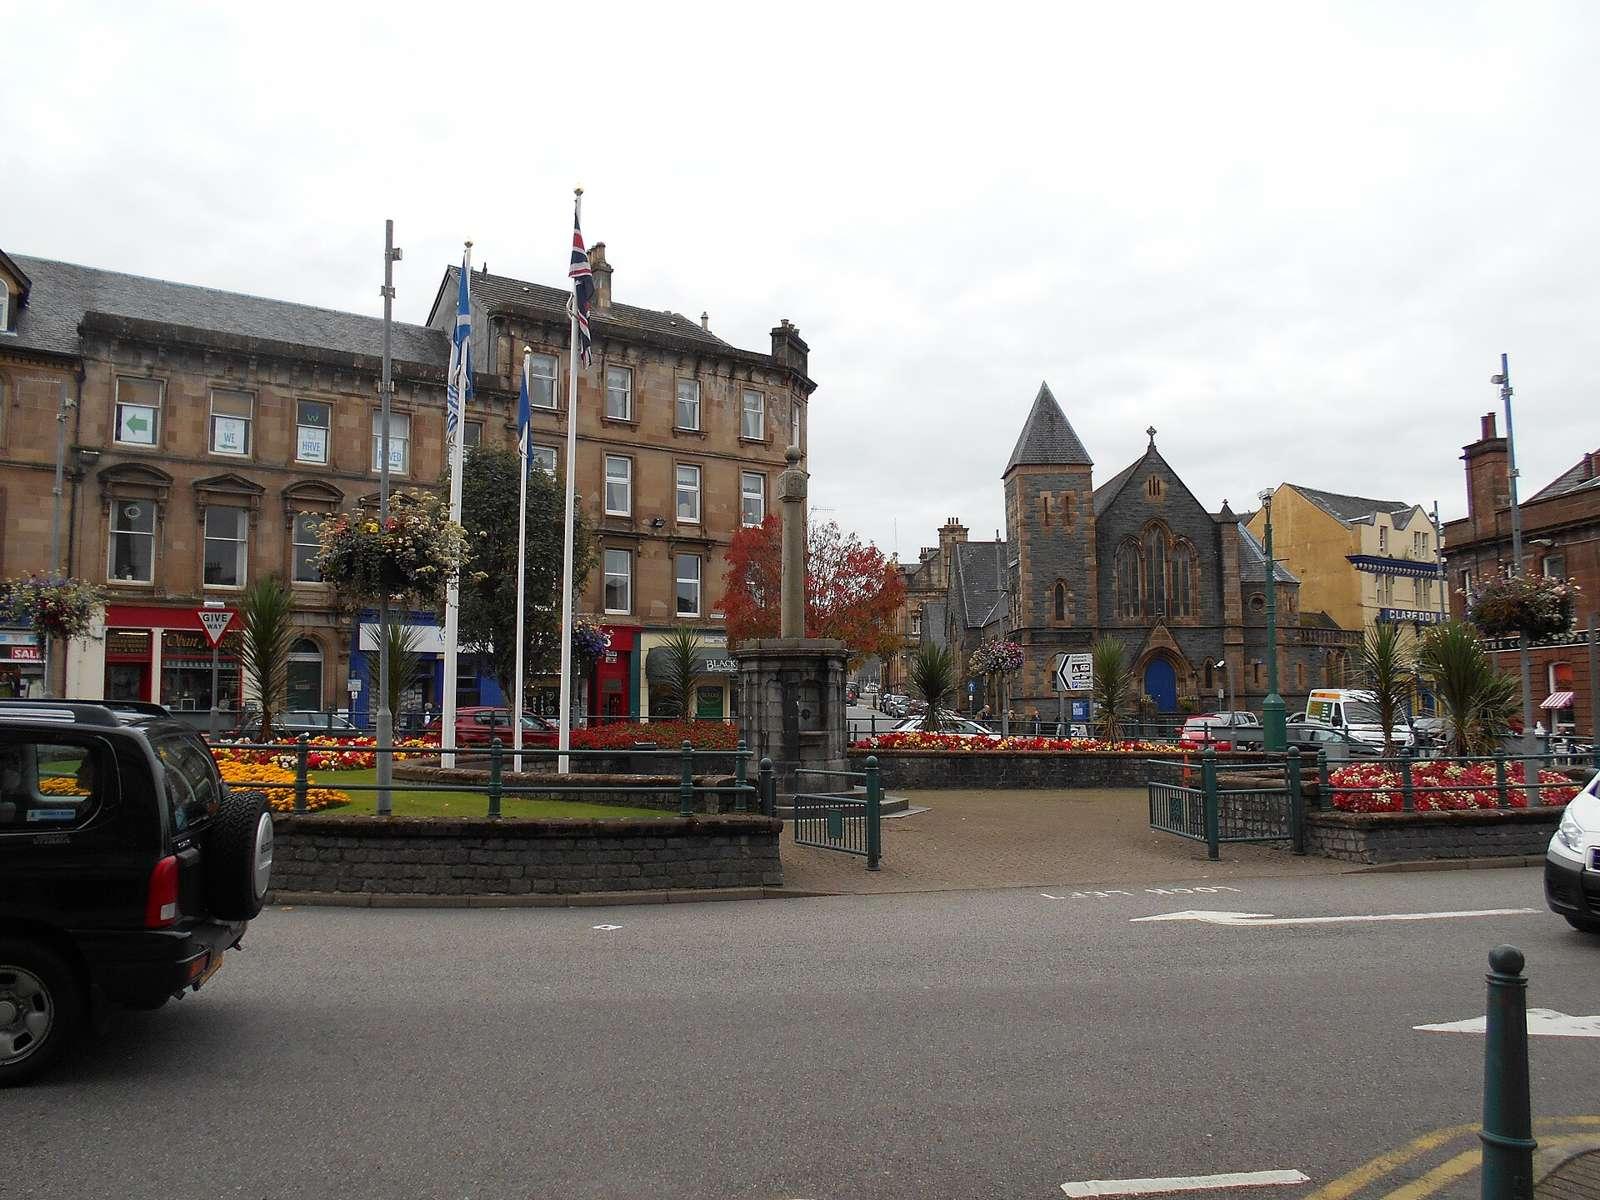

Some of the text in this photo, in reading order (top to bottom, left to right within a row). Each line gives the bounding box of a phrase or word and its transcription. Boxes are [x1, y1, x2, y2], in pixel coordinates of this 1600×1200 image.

[223, 432, 235, 443] WE
[302, 440, 320, 451] HAVE
[202, 614, 227, 622] GIVE
[14, 649, 39, 659] SAL
